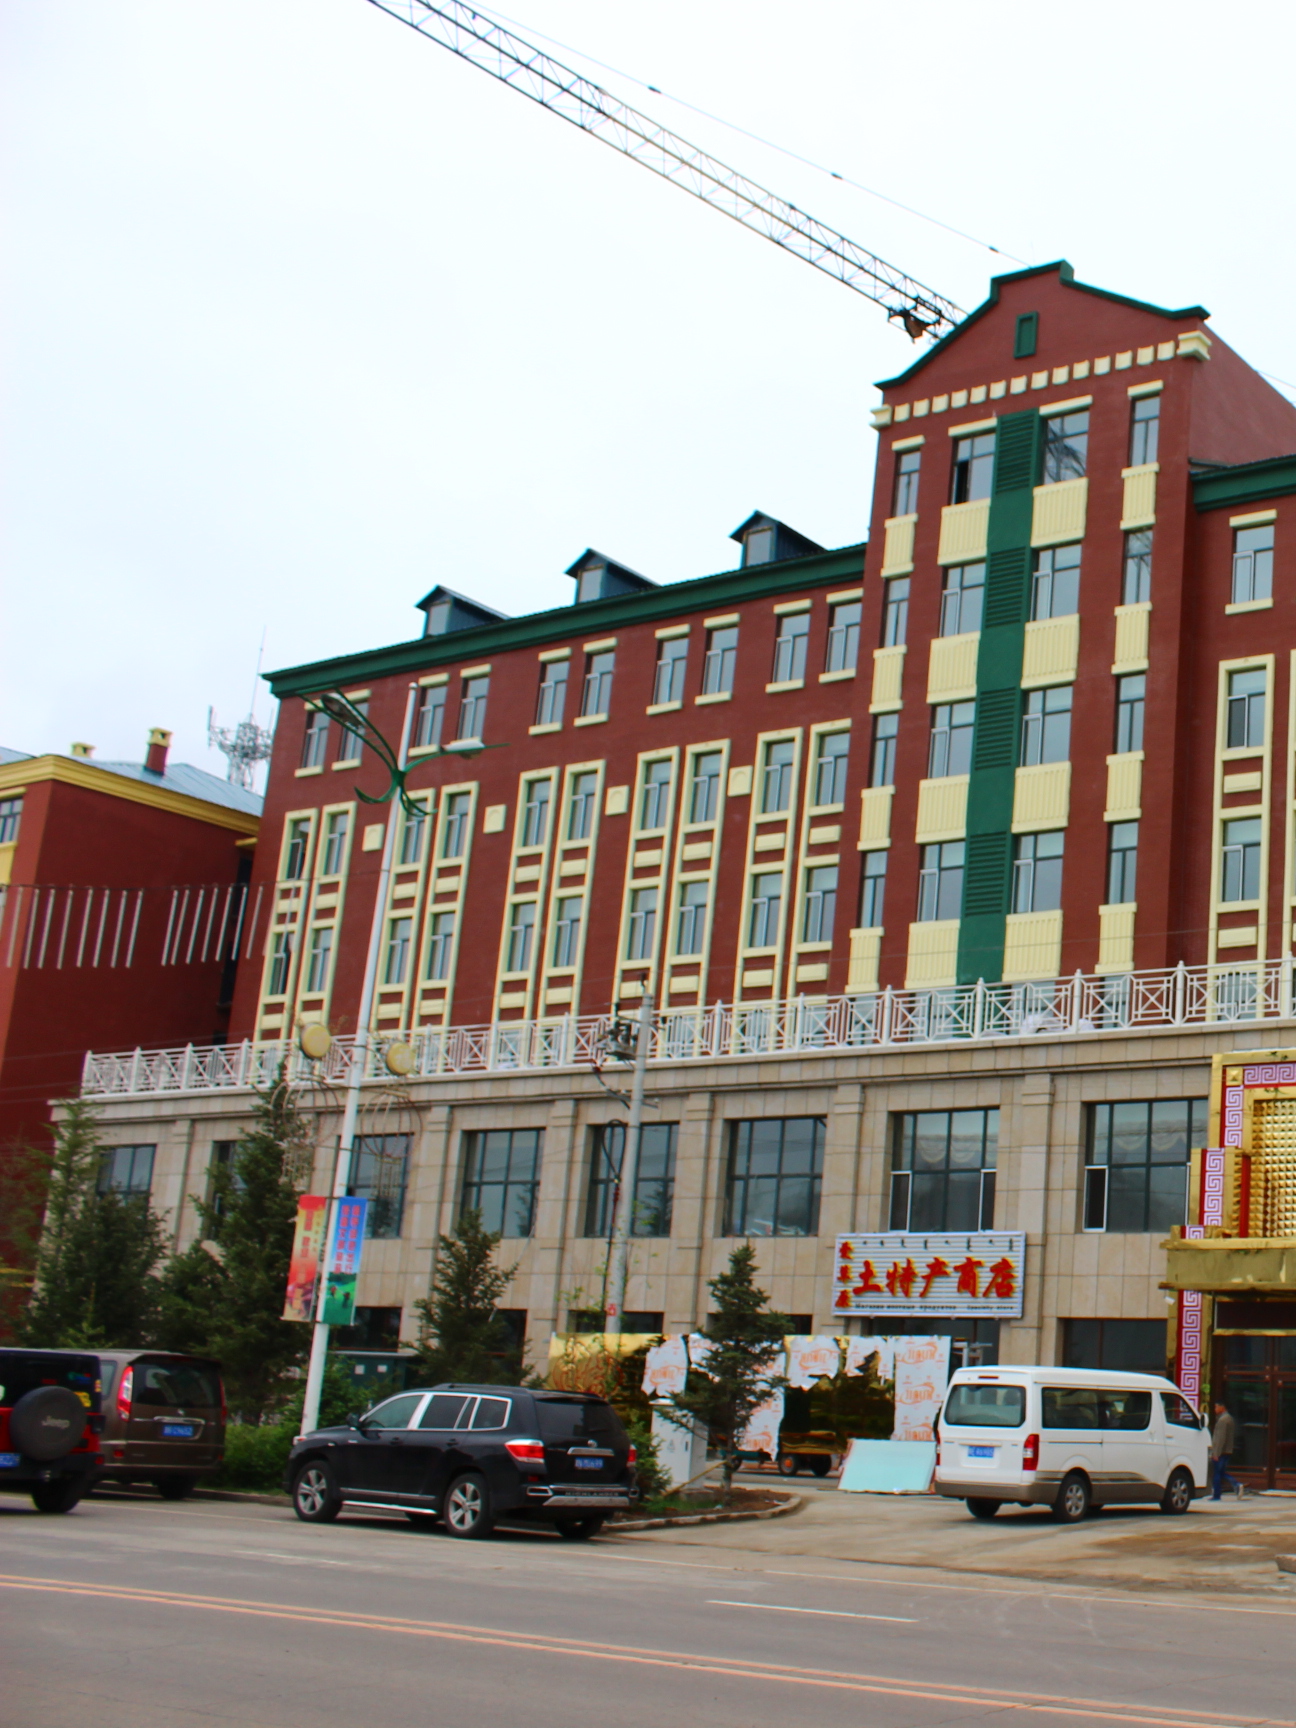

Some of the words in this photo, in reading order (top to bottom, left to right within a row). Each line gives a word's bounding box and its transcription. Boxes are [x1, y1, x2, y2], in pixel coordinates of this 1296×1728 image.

[852, 1256, 1017, 1298] 土特产商店
